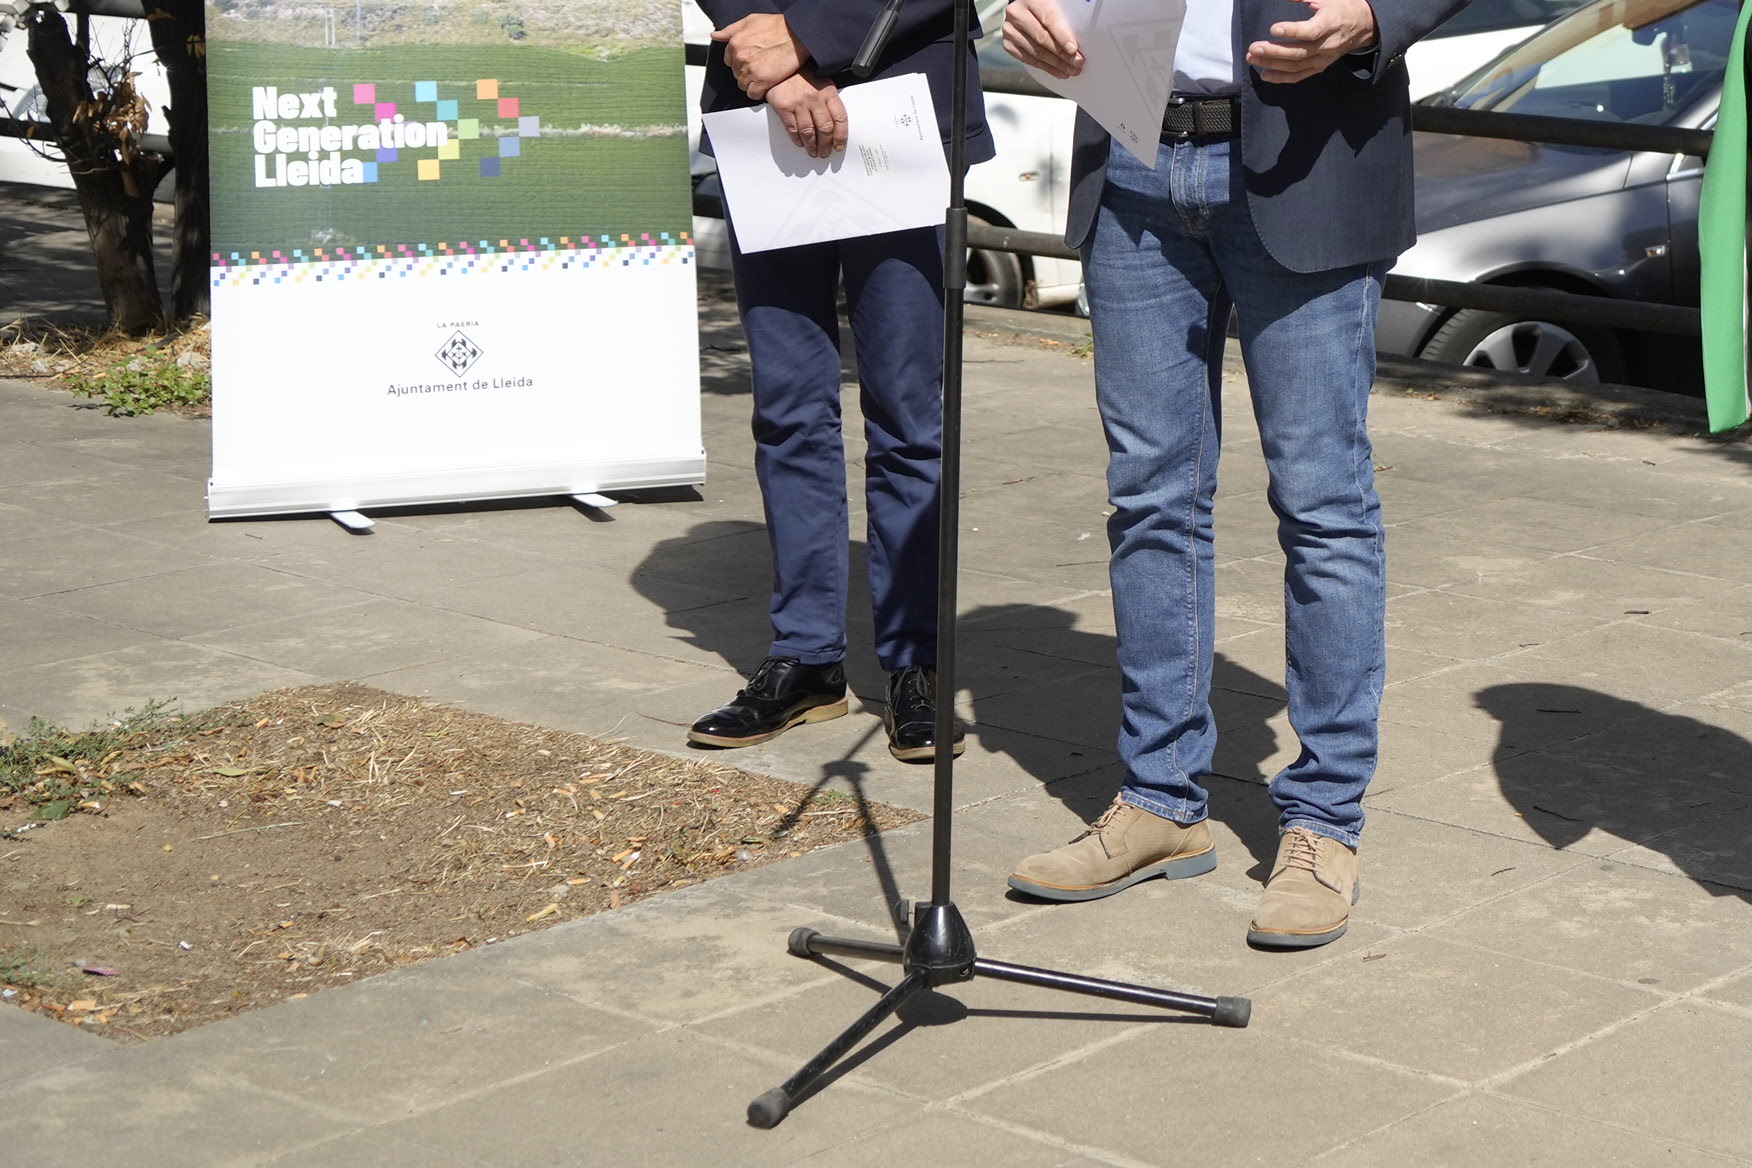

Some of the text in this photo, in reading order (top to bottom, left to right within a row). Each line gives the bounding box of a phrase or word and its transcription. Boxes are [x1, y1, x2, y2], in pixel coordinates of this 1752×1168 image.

[252, 86, 338, 120] Next
[253, 113, 448, 154] Generation
[254, 150, 365, 188] Lleida
[450, 320, 480, 328] PAERIA
[387, 376, 534, 397] Ajuntament de Lleida
